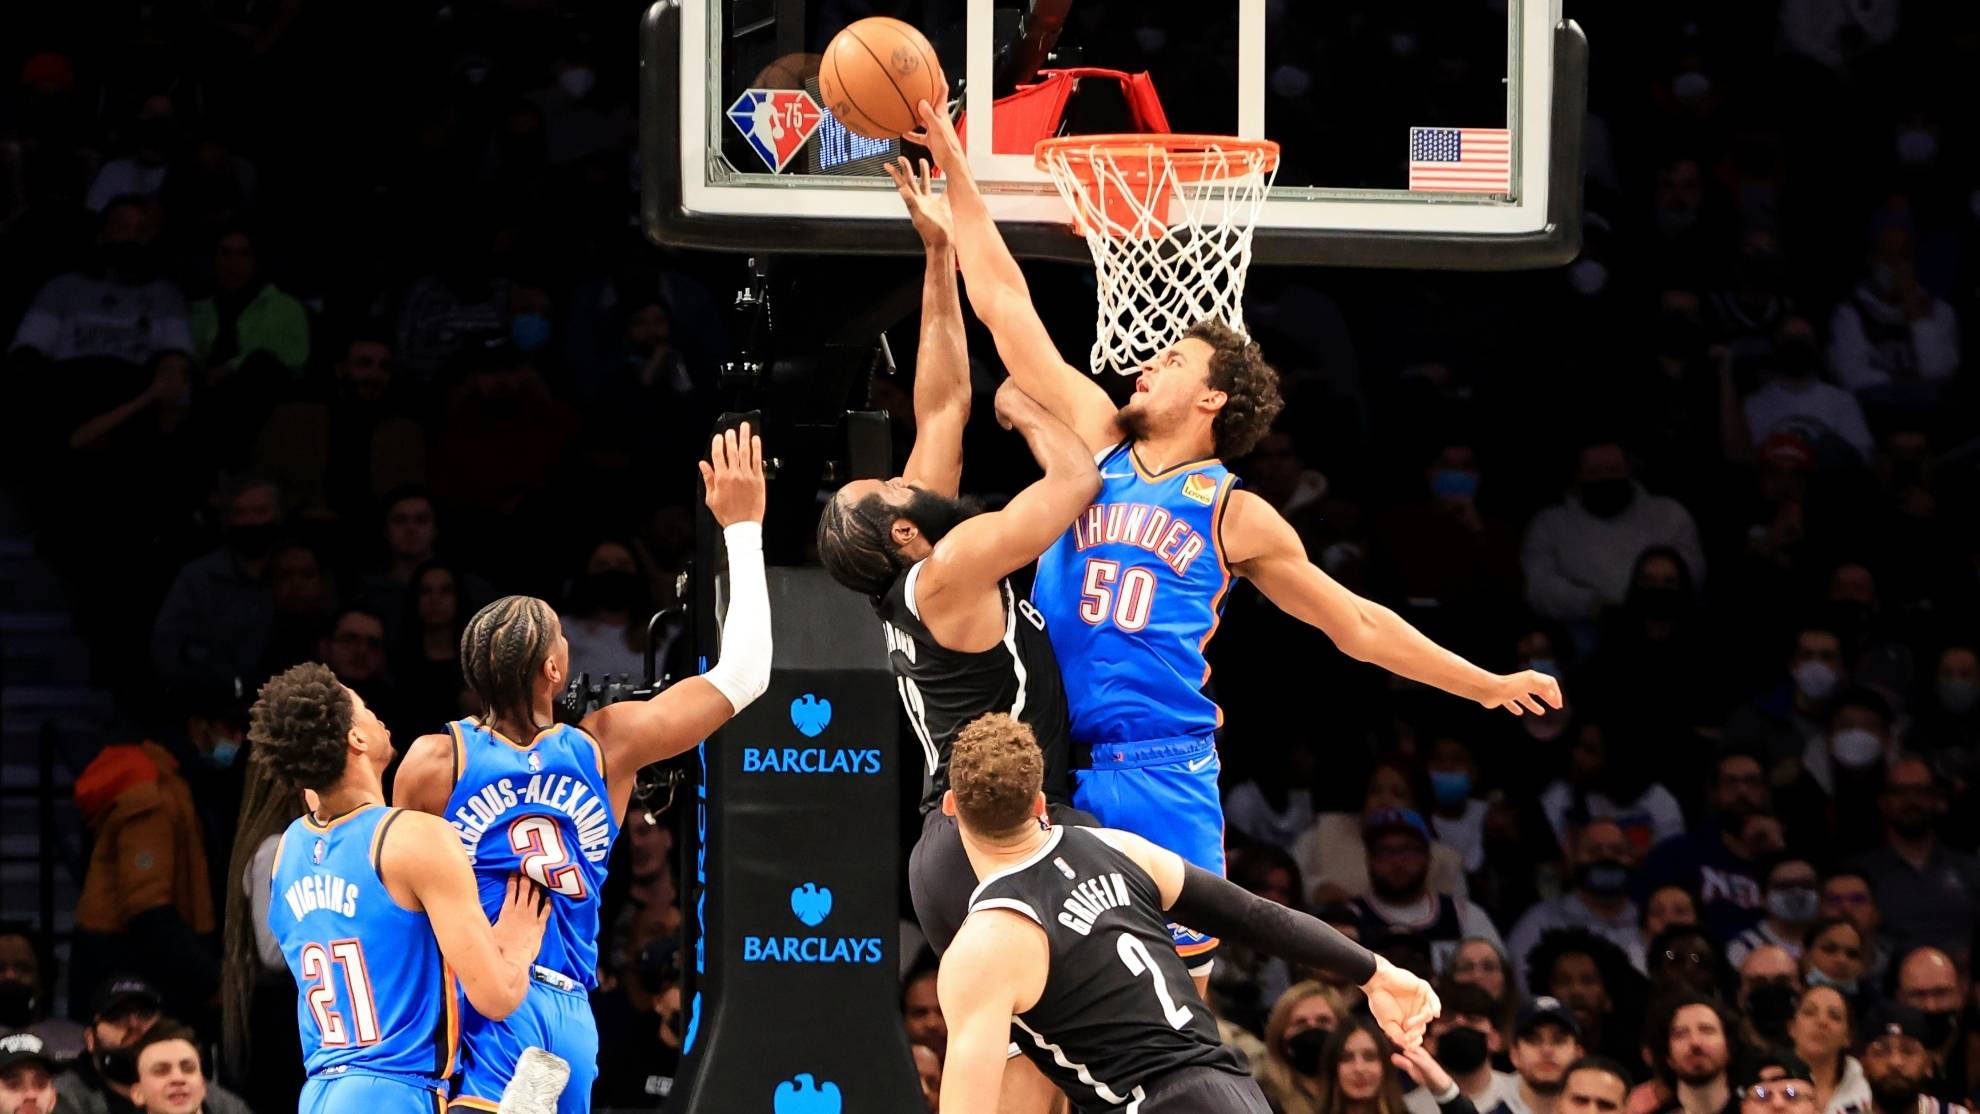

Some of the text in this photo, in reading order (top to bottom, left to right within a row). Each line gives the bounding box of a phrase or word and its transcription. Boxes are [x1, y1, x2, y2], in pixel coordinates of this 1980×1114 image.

[784, 102, 803, 128] 75
[1080, 558, 1157, 633] 50
[743, 747, 882, 774] BARCLAYS
[507, 812, 587, 899] 2
[1057, 872, 1131, 936] GRIFFIN
[743, 936, 883, 962] BARCLAYS
[1116, 932, 1194, 1030] 2
[301, 937, 382, 1047] 21
